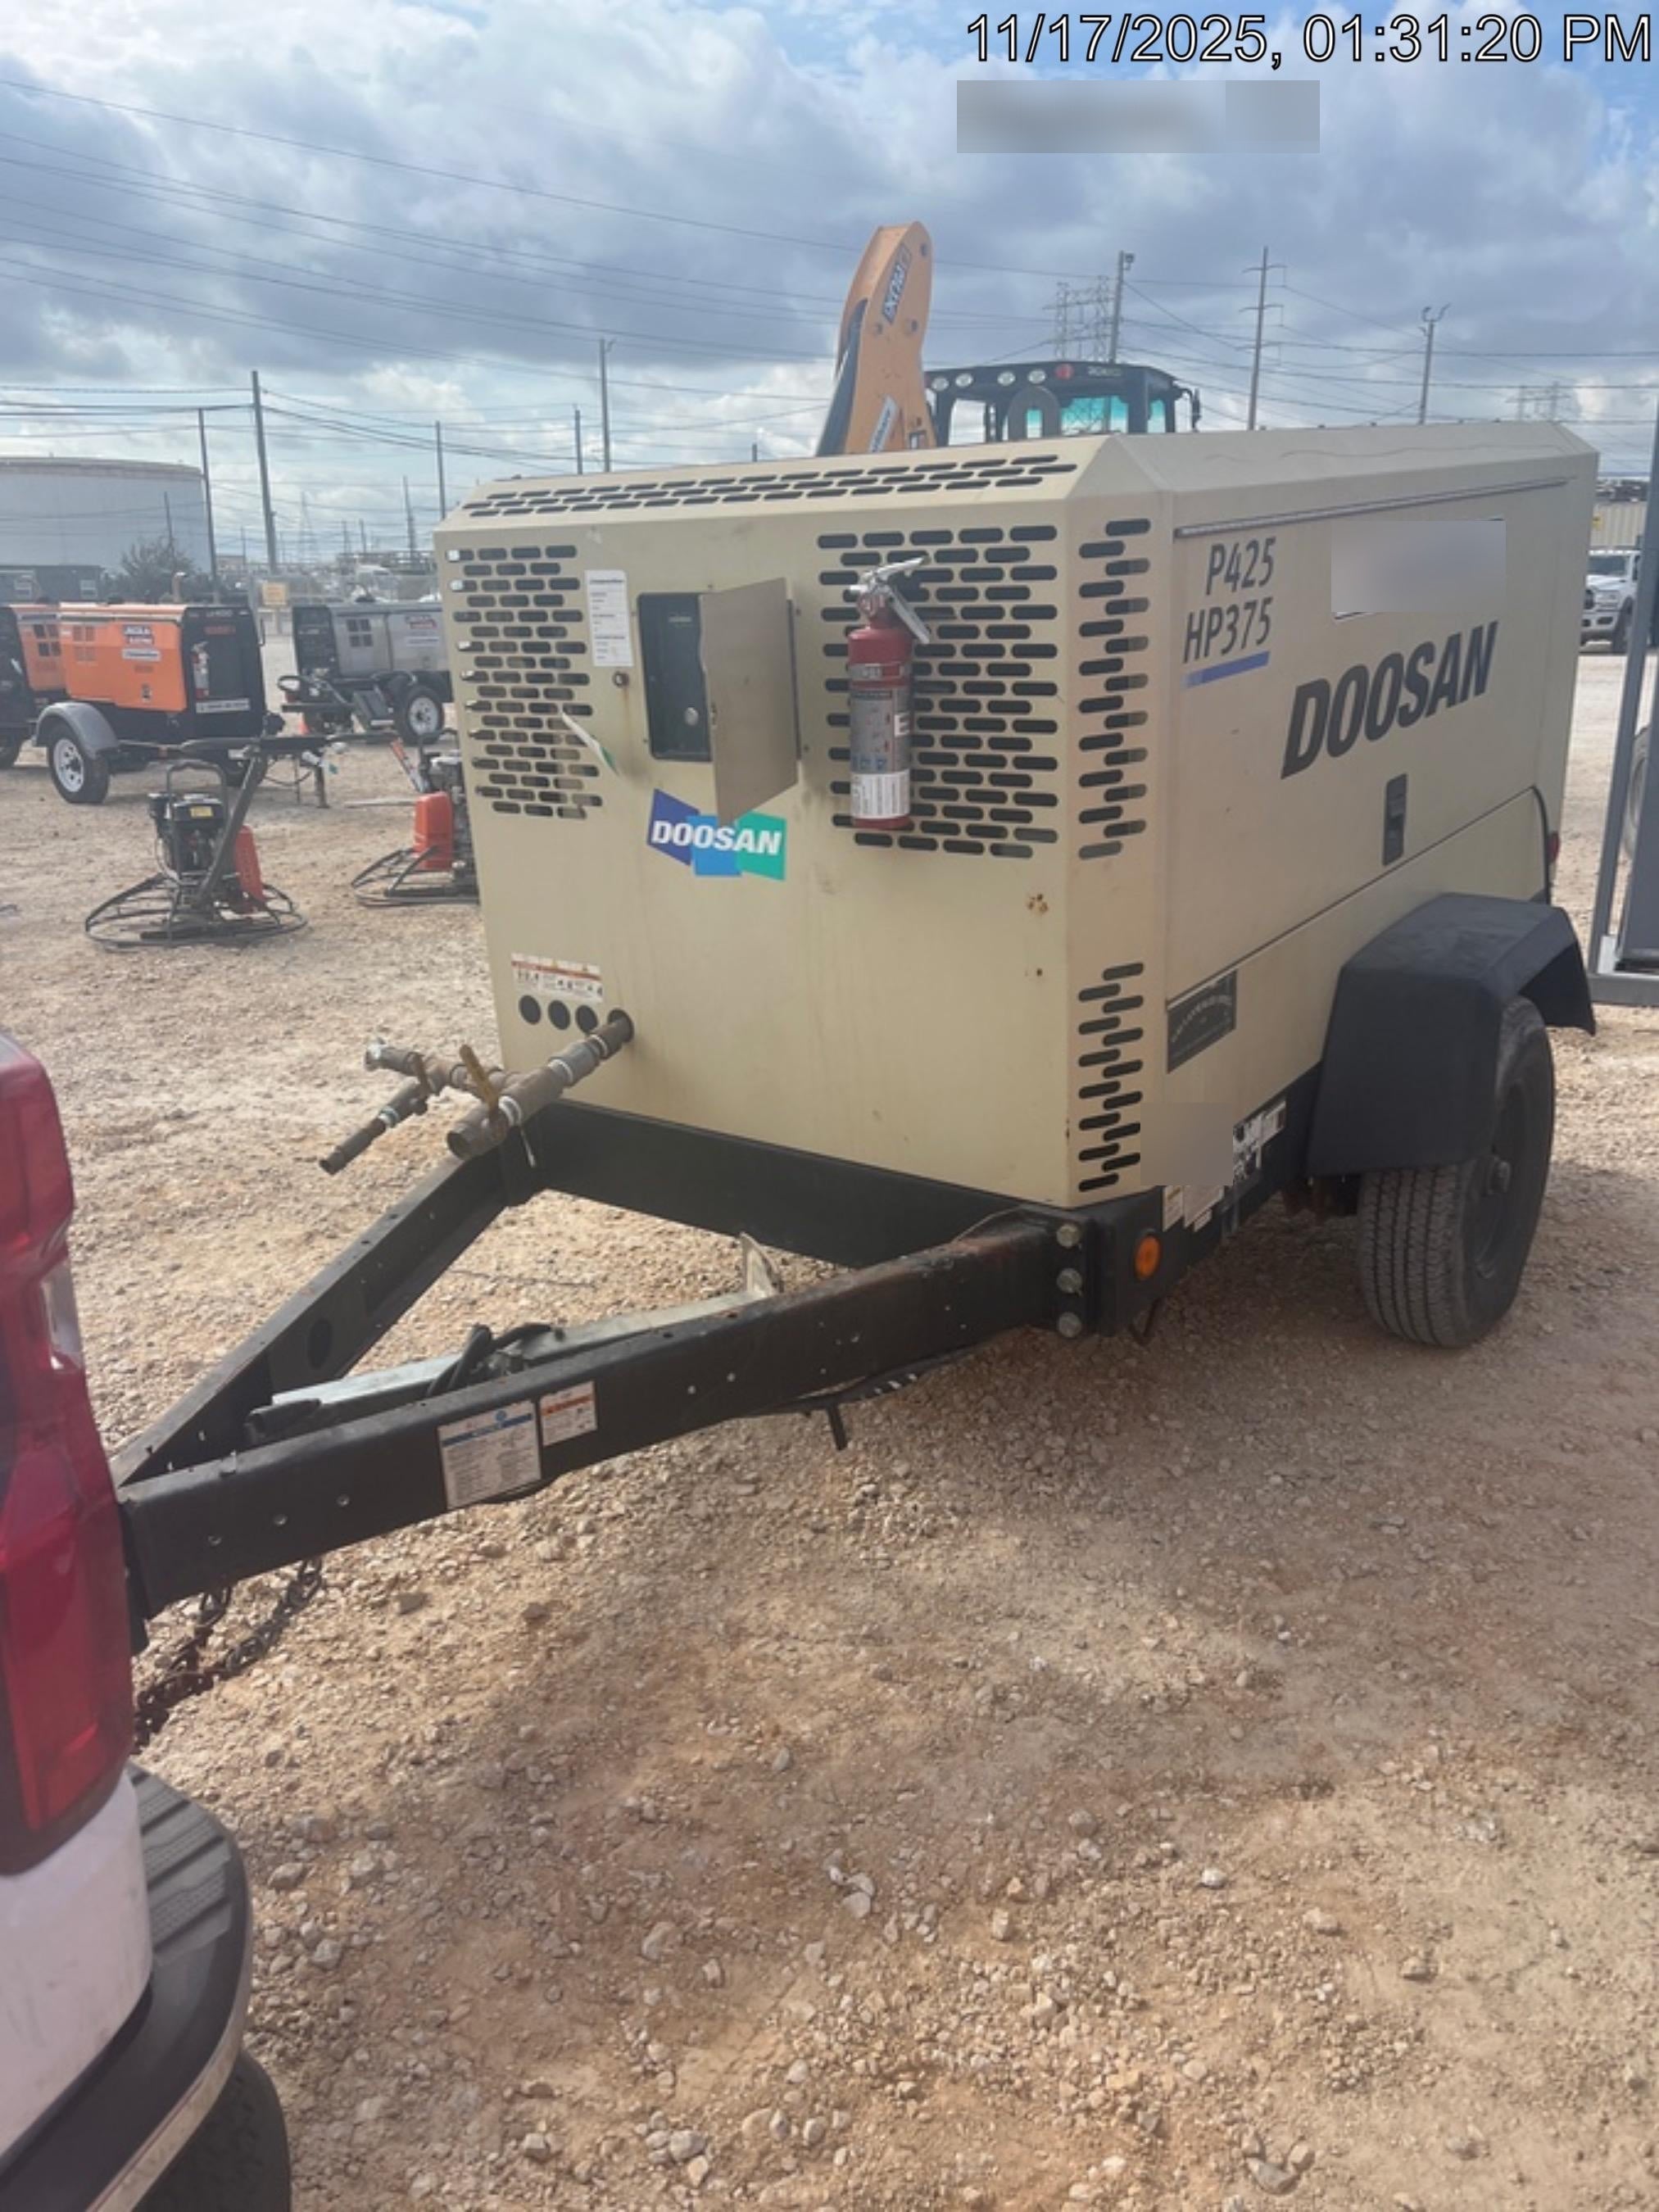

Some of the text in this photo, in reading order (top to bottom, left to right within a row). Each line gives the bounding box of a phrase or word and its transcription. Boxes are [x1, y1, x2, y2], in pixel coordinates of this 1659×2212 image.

[1206, 537, 1276, 596] P425
[1183, 597, 1273, 664] HP375
[1281, 620, 1498, 779] DOOSAN
[650, 820, 782, 855] DOOSAN
